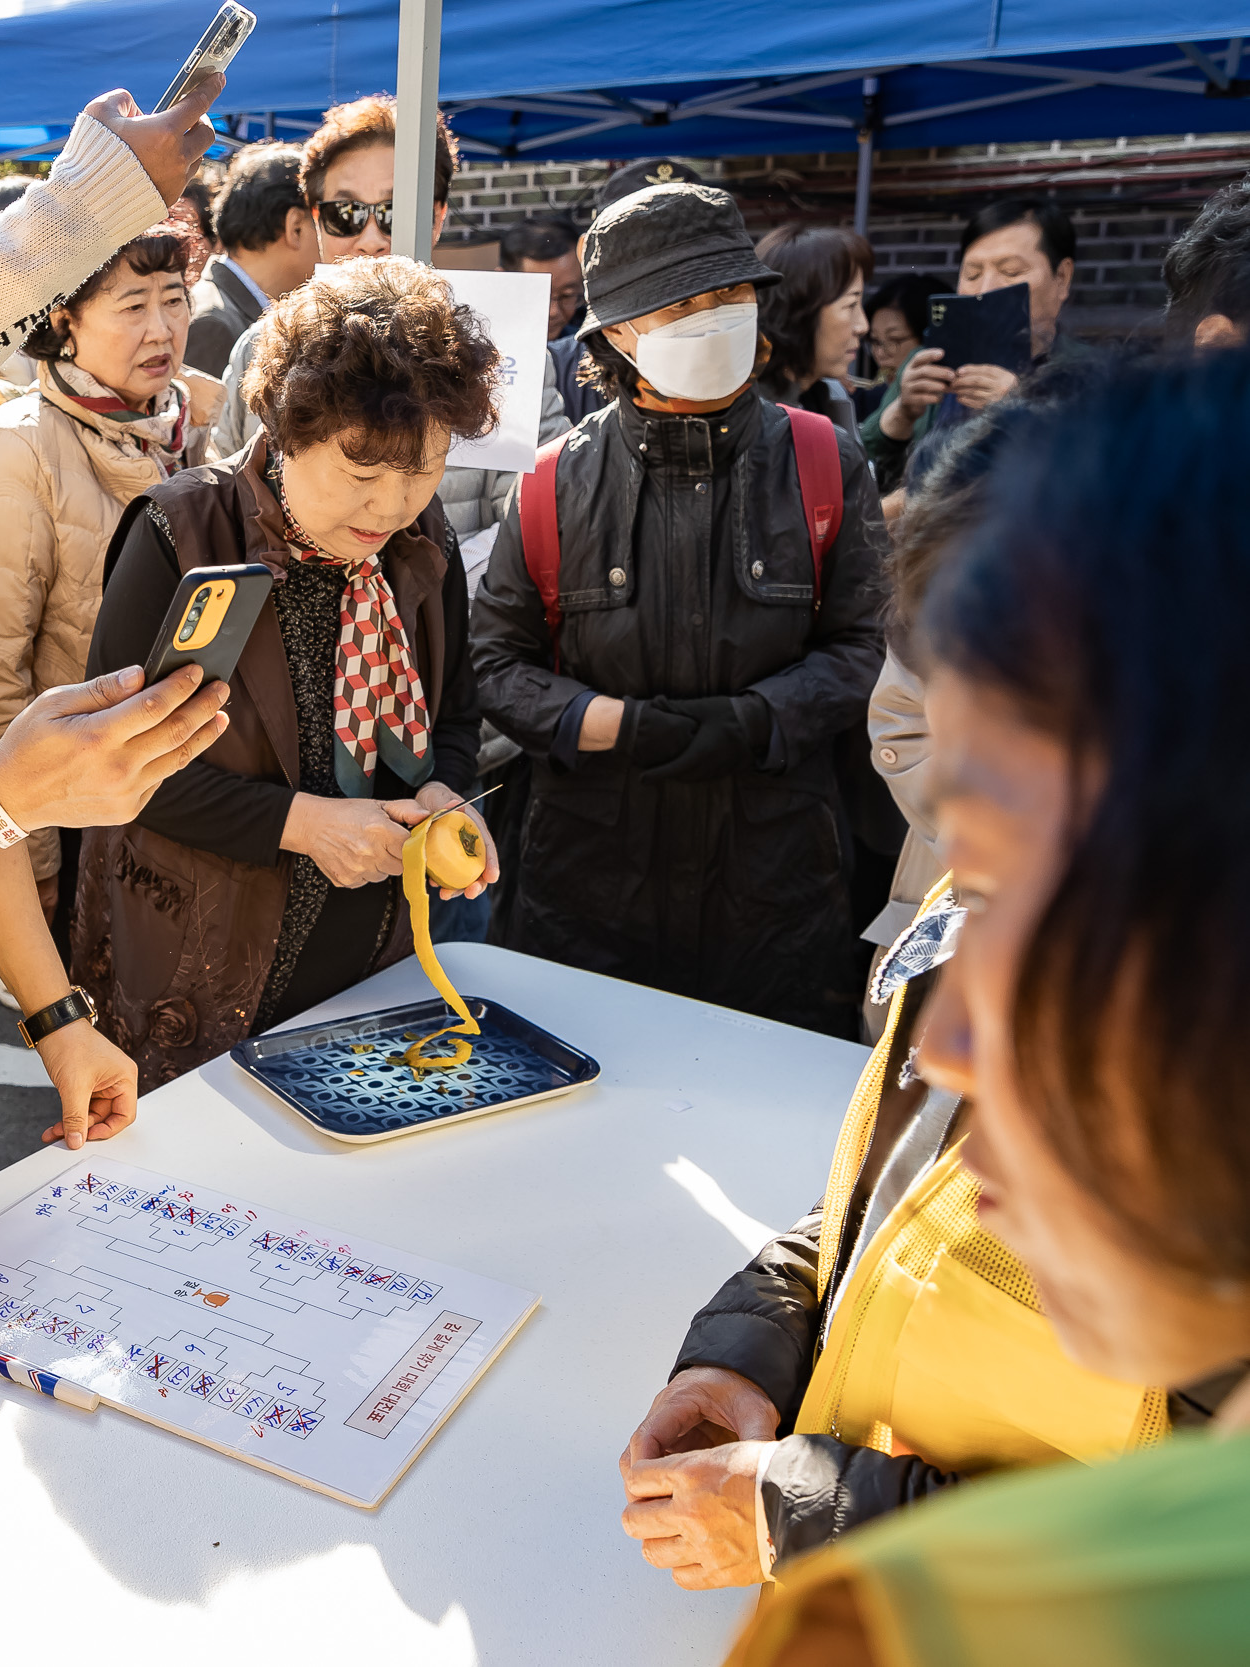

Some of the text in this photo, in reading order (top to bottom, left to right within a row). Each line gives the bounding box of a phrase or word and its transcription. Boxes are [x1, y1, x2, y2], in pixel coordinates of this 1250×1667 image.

[93, 1203, 107, 1212] 4
[173, 1280, 199, 1297] 결 승
[77, 1304, 94, 1314] 7
[184, 1343, 205, 1355] 6
[366, 1322, 462, 1422] 감 길게 깎기 대회 대진표
[277, 1382, 297, 1396] 5
